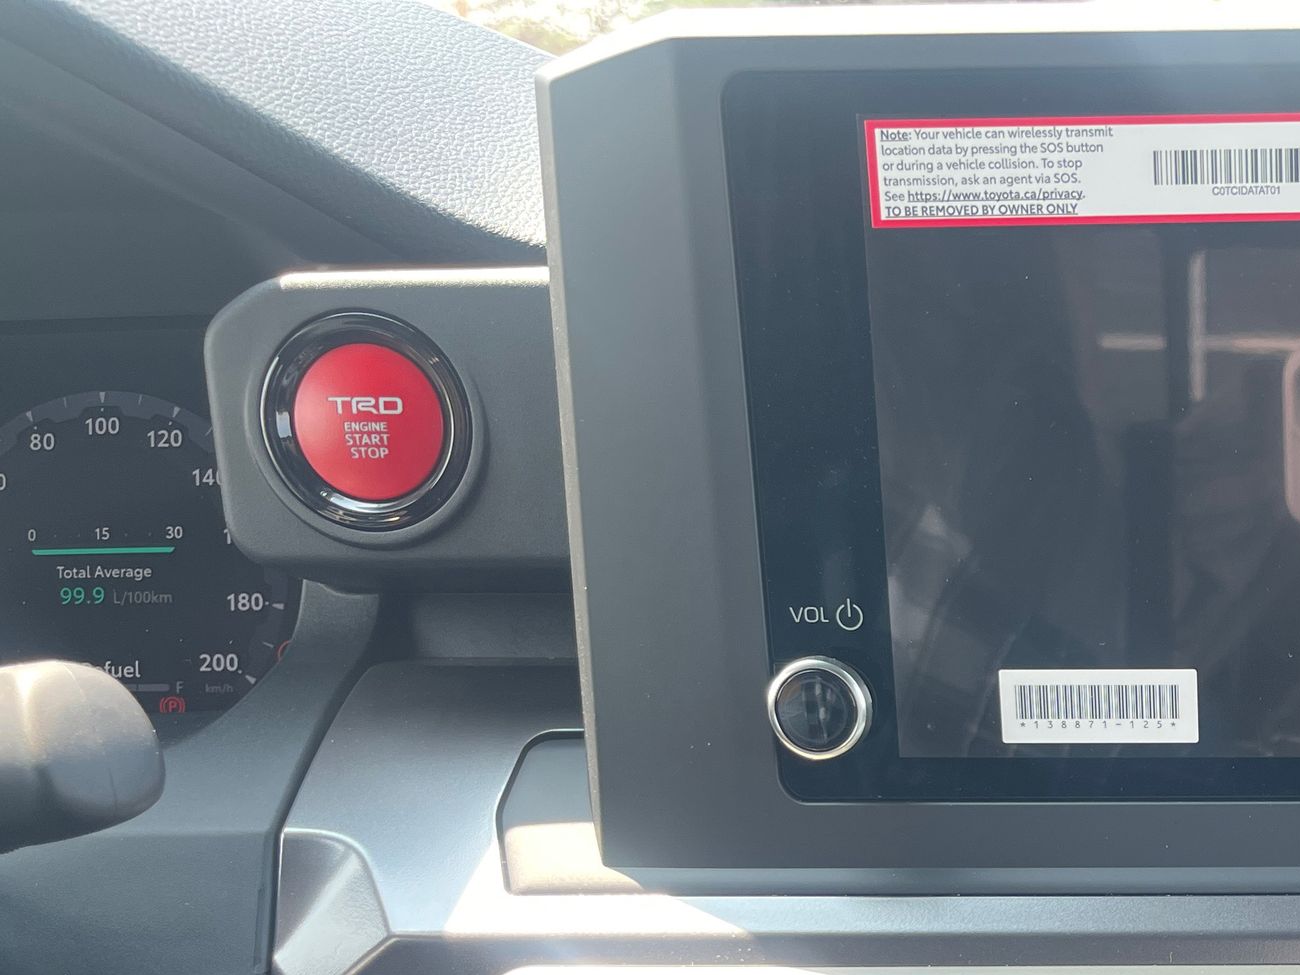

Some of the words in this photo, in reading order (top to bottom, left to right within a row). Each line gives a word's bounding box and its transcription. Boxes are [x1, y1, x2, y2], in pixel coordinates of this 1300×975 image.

[880, 130, 912, 142] Note:
[914, 130, 940, 140] Your
[942, 128, 982, 139] vehicle
[985, 129, 1004, 139] can
[1008, 127, 1063, 140] wirelessly
[1065, 125, 1113, 138] transmit
[881, 145, 926, 156] location
[928, 144, 952, 155] data
[955, 144, 968, 157] by
[971, 144, 1017, 157] pressing
[1020, 143, 1038, 154] the
[1040, 142, 1063, 153] SOS
[1066, 142, 1104, 153] button
[882, 162, 894, 171] or
[896, 160, 933, 173] during
[937, 162, 943, 170] a
[946, 159, 986, 170] vehicle
[988, 158, 1039, 169] collision.
[1041, 158, 1055, 169] To
[1057, 158, 1083, 170] stop
[883, 175, 958, 187] transmission,
[961, 174, 980, 185] ask
[983, 176, 997, 186] an
[1000, 174, 1033, 187] agent
[1035, 173, 1051, 184] via
[1054, 173, 1081, 184] SOS.
[884, 191, 905, 202] See
[907, 188, 1086, 203] https://www.toyota.ca/privacy.
[885, 206, 901, 218] TO
[904, 206, 918, 217] BE
[922, 205, 979, 217] REMOVED
[982, 205, 996, 216] BY
[998, 204, 1043, 216] OWNER
[1046, 203, 1078, 215] ONLY
[327, 396, 403, 415] TRD
[84, 416, 120, 436] 100
[344, 421, 388, 432] ENGINE
[29, 432, 55, 451] 80
[147, 429, 183, 448] 120
[345, 433, 390, 446] START
[350, 447, 389, 459] STOP
[27, 529, 36, 541] 0
[95, 527, 110, 540] 15
[165, 526, 183, 539] 30
[57, 566, 91, 579] Total
[94, 566, 152, 581] Average
[59, 586, 105, 605] 99.9
[113, 590, 172, 604] L/100km
[226, 592, 264, 611] 180
[788, 606, 829, 623] VOL
[199, 653, 239, 672] 200
[176, 681, 184, 693] F
[205, 684, 234, 693] km/h
